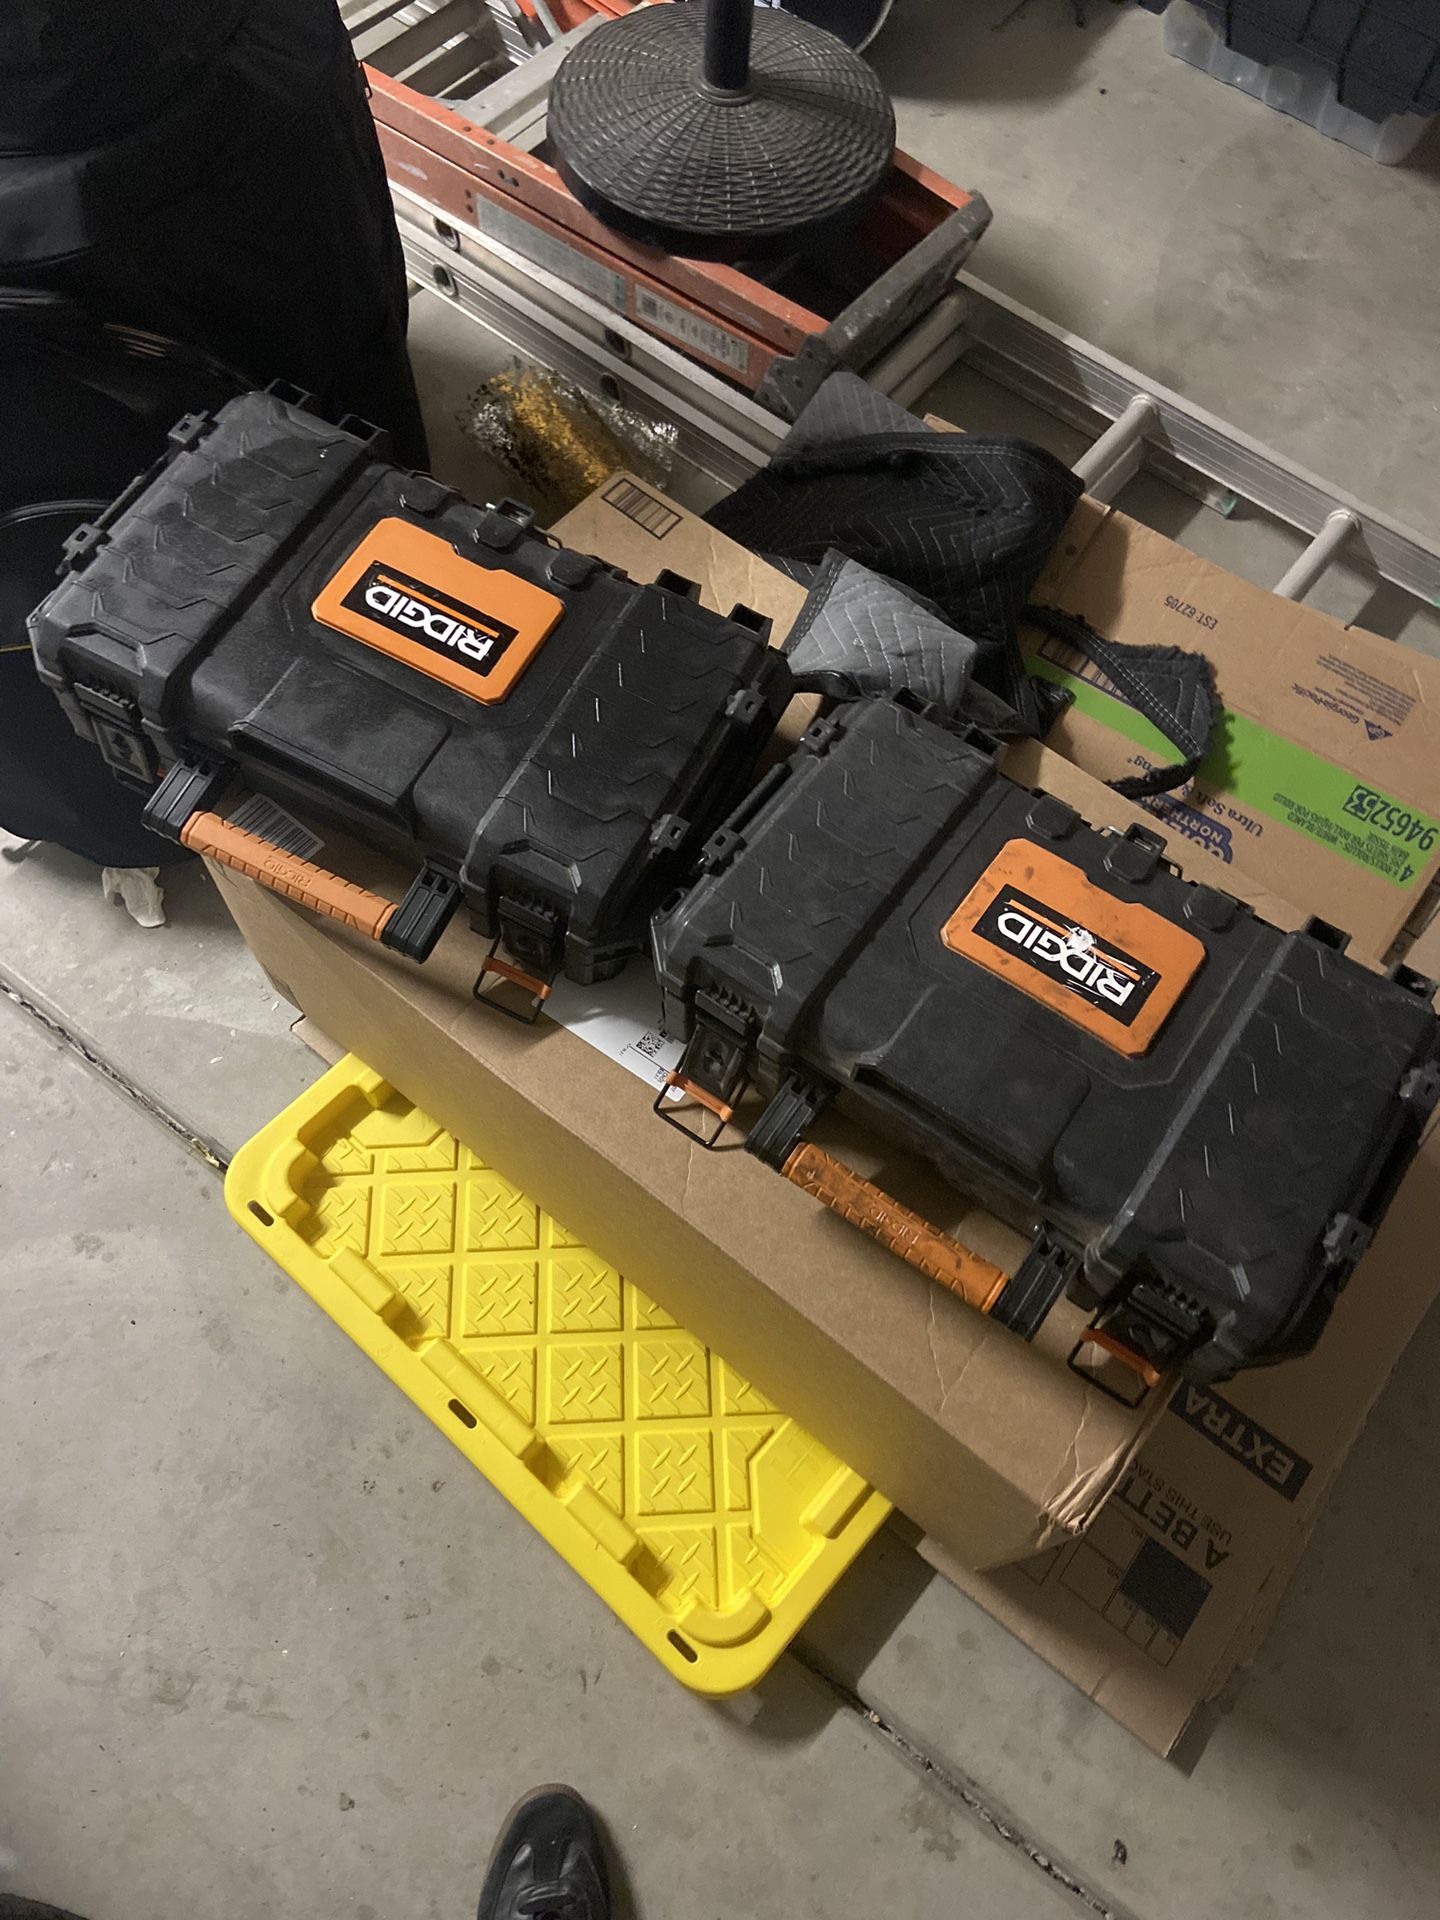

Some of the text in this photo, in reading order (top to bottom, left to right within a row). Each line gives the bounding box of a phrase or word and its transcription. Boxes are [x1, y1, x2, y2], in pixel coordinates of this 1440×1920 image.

[1163, 595, 1196, 618] 62705
[365, 584, 494, 661] RIDGID
[1191, 790, 1226, 816] Soft
[1224, 807, 1265, 837] Ultra
[1400, 864, 1414, 882] 4
[997, 911, 1135, 1006] RIDGID
[1183, 1384, 1295, 1485] EXTRA
[1163, 1486, 1200, 1520] THIS
[1199, 1513, 1233, 1544] USE
[1204, 1538, 1229, 1569] A
